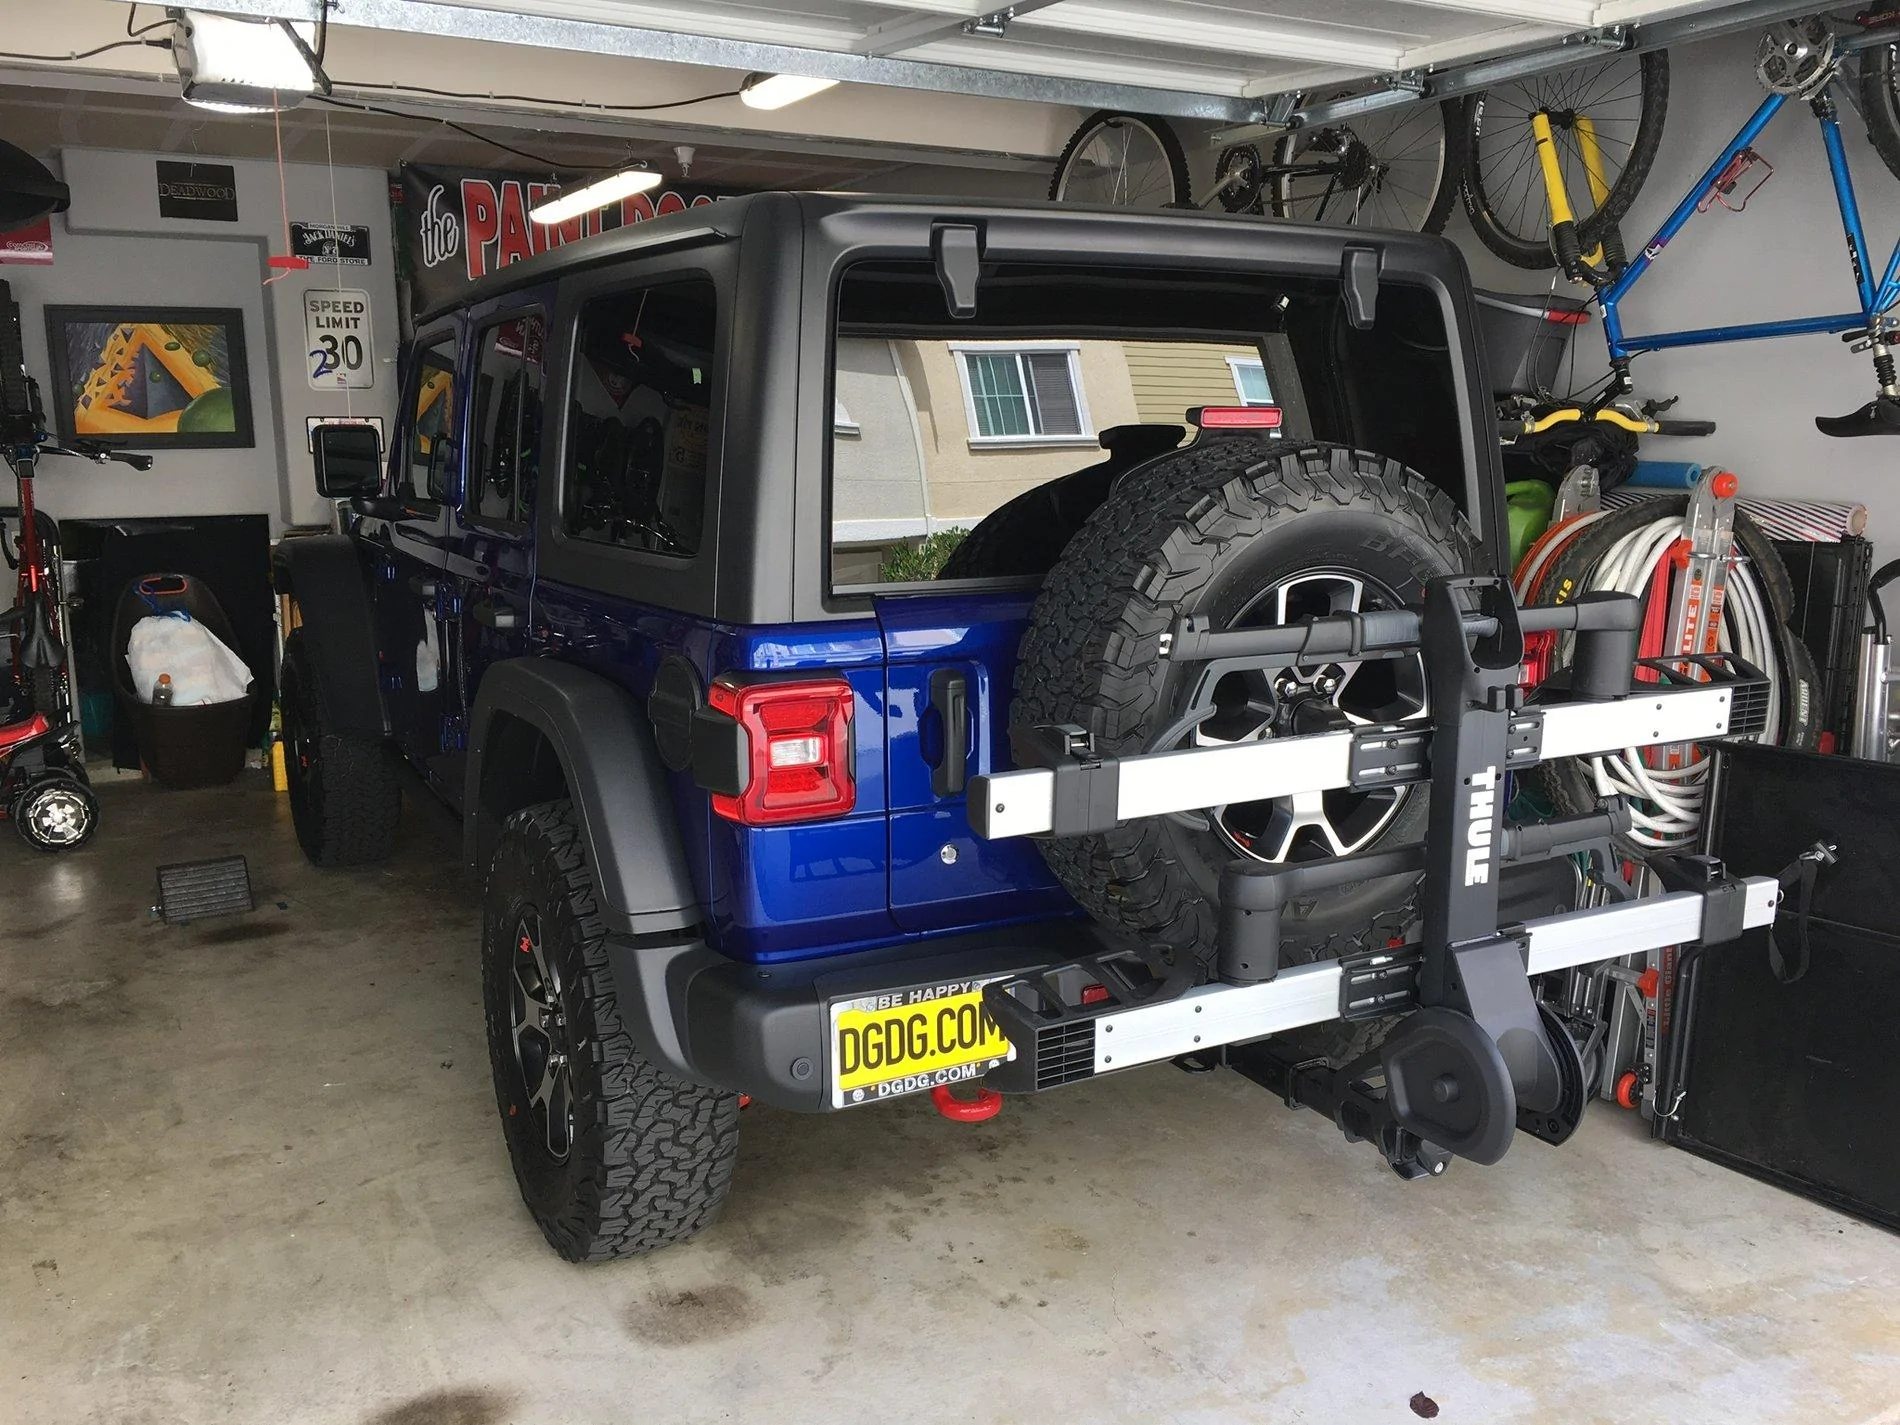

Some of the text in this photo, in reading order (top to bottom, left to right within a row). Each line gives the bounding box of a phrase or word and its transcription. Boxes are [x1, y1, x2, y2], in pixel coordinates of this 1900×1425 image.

[159, 183, 235, 200] DEADWOOD
[302, 230, 324, 245] JACK
[421, 185, 459, 267] the
[310, 300, 365, 313] SPEED
[315, 316, 361, 329] LIMIT
[308, 349, 333, 379] 2
[319, 334, 363, 370] 30
[1464, 765, 1496, 887] THULE
[1664, 946, 1673, 985] Giant
[878, 981, 972, 1010] BE HAPPY
[878, 1063, 976, 1097] DGDG.COM
